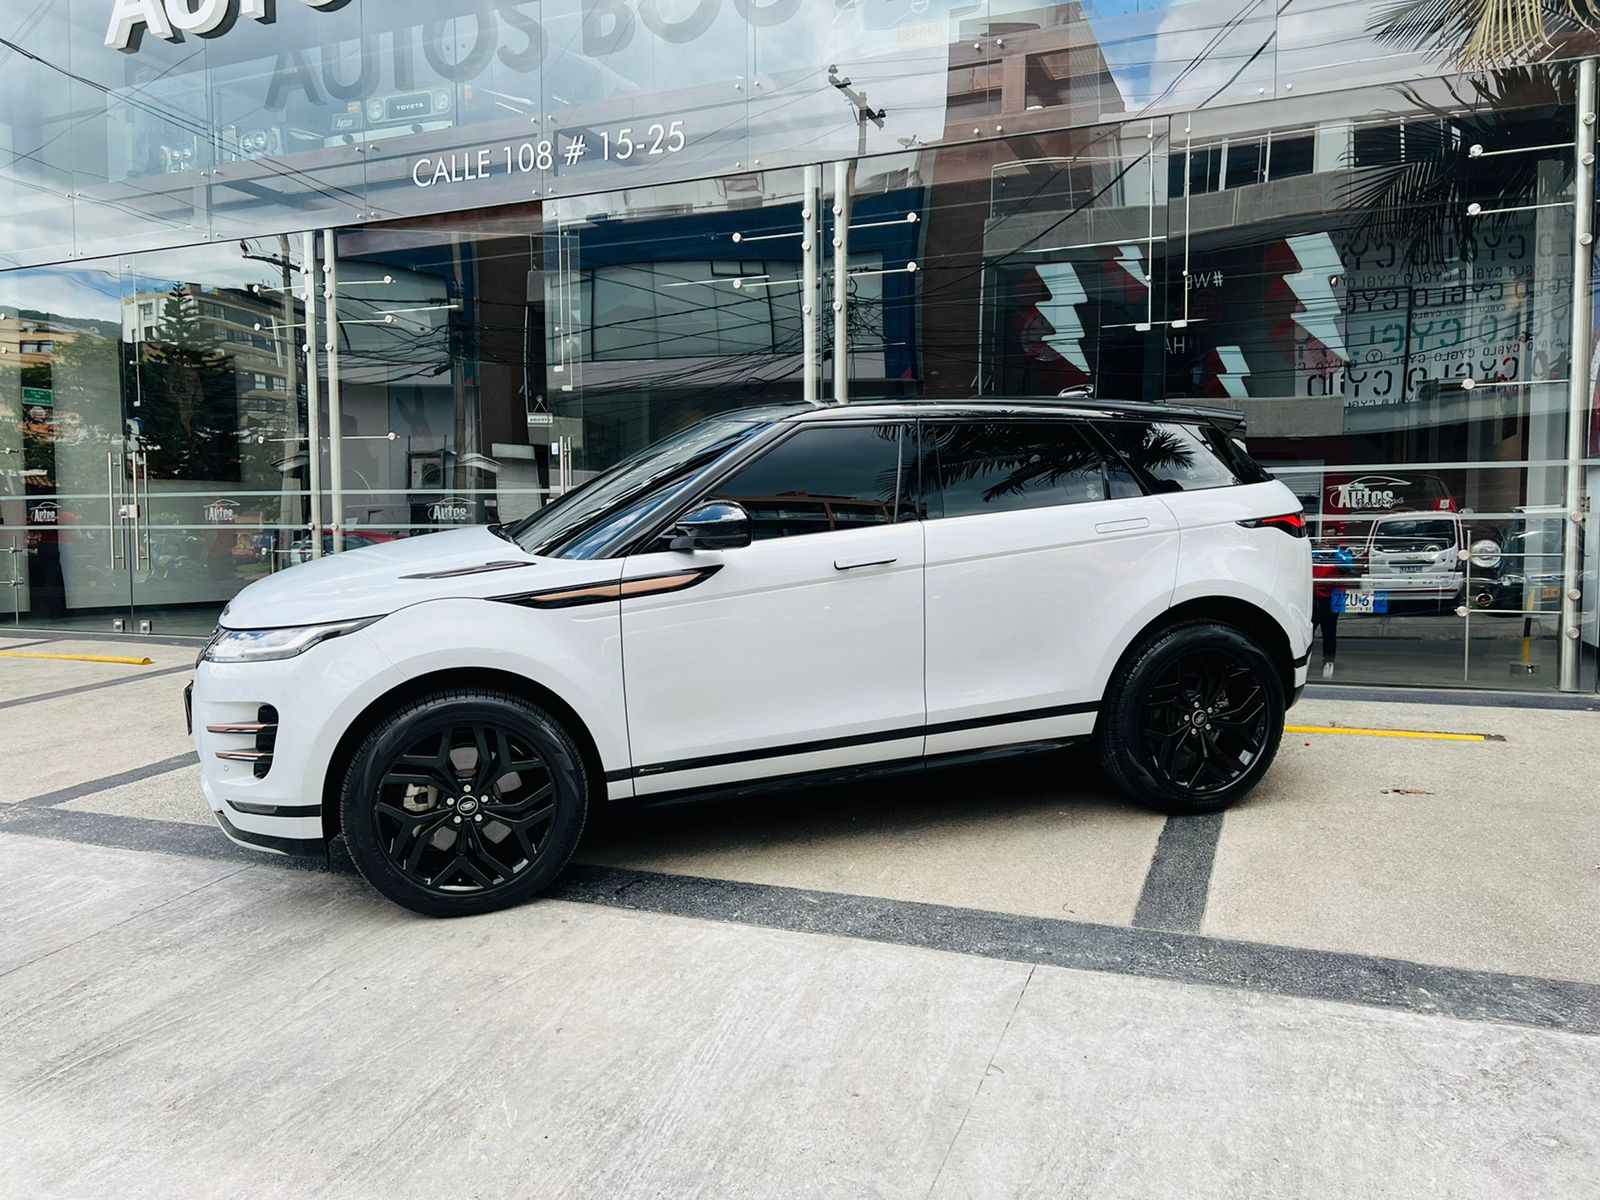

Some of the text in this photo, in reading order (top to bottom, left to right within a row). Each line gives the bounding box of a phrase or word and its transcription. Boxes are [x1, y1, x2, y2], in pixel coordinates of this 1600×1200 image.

[395, 102, 424, 111] TOYOTA
[412, 120, 687, 187] CALLE 108 # 15-25
[1337, 486, 1394, 508] Autos
[34, 509, 56, 521] Autos
[433, 505, 467, 520] Autos
